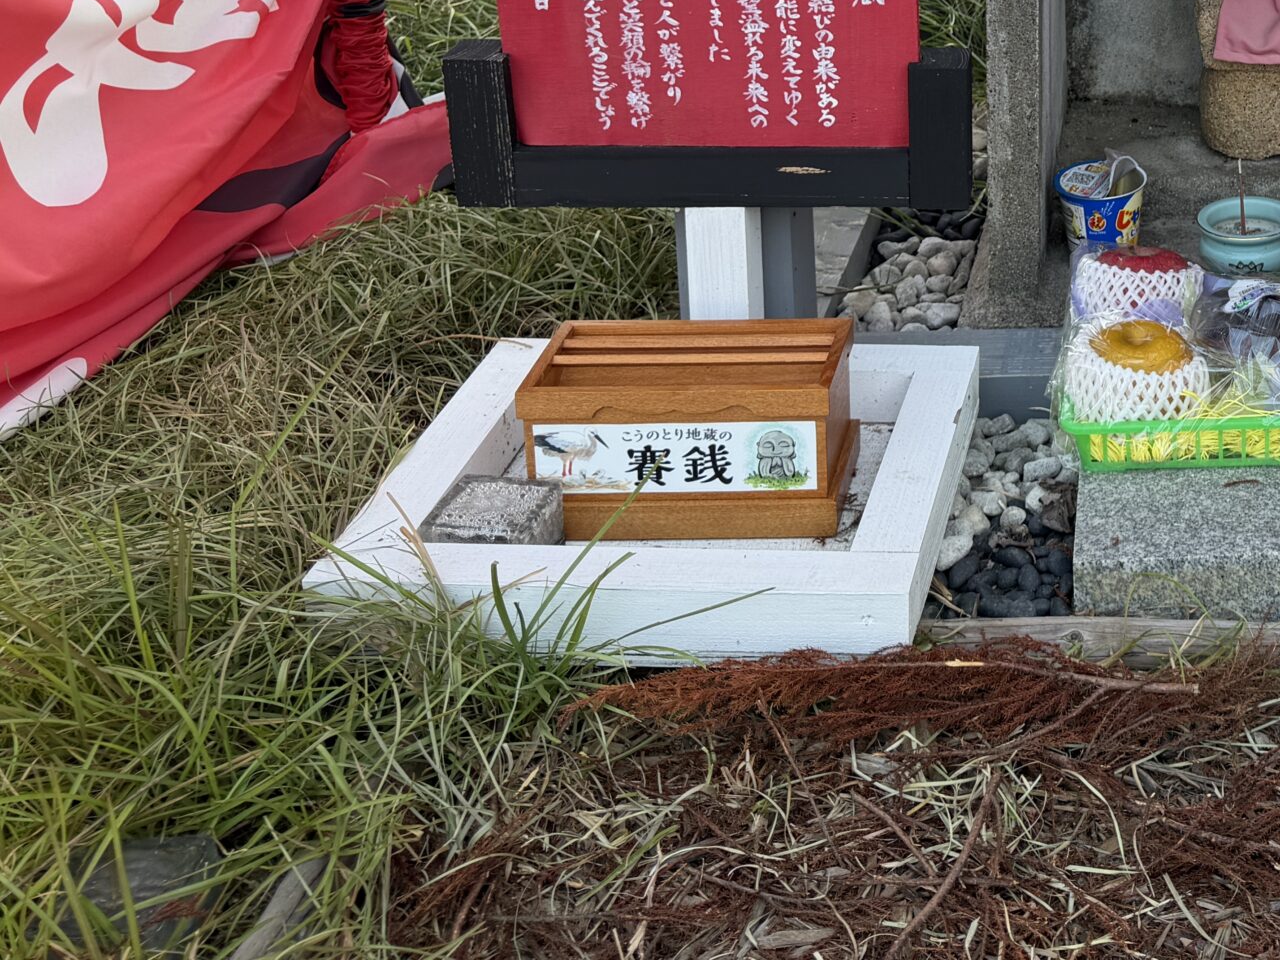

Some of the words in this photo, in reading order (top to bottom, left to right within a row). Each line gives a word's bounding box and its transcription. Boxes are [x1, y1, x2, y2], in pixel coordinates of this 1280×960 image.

[621, 427, 733, 443] こうのとり地蔵の
[625, 444, 734, 487] 賽銭
